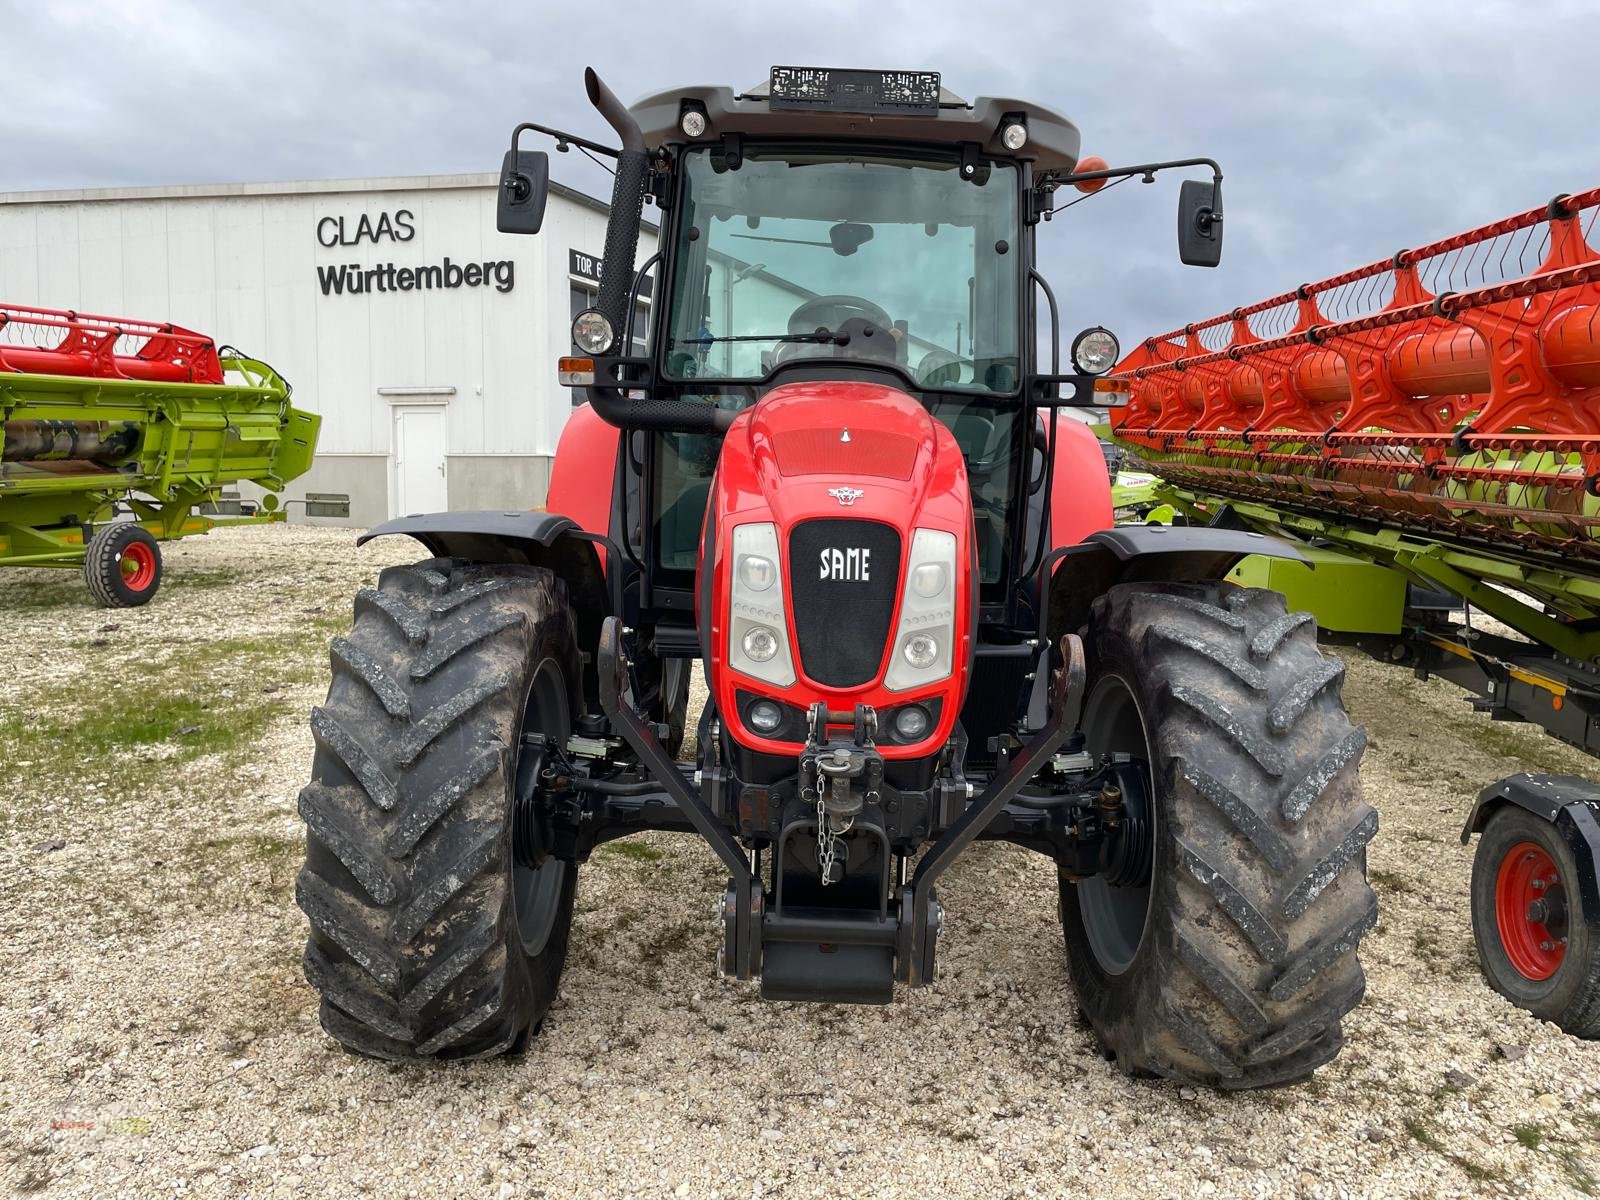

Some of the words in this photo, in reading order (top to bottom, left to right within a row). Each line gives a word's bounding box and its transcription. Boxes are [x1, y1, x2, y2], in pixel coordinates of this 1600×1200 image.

[317, 209, 415, 247] CLAAS
[317, 257, 515, 294] Württemberg
[575, 254, 592, 275] TOR
[820, 548, 870, 581] SAME
